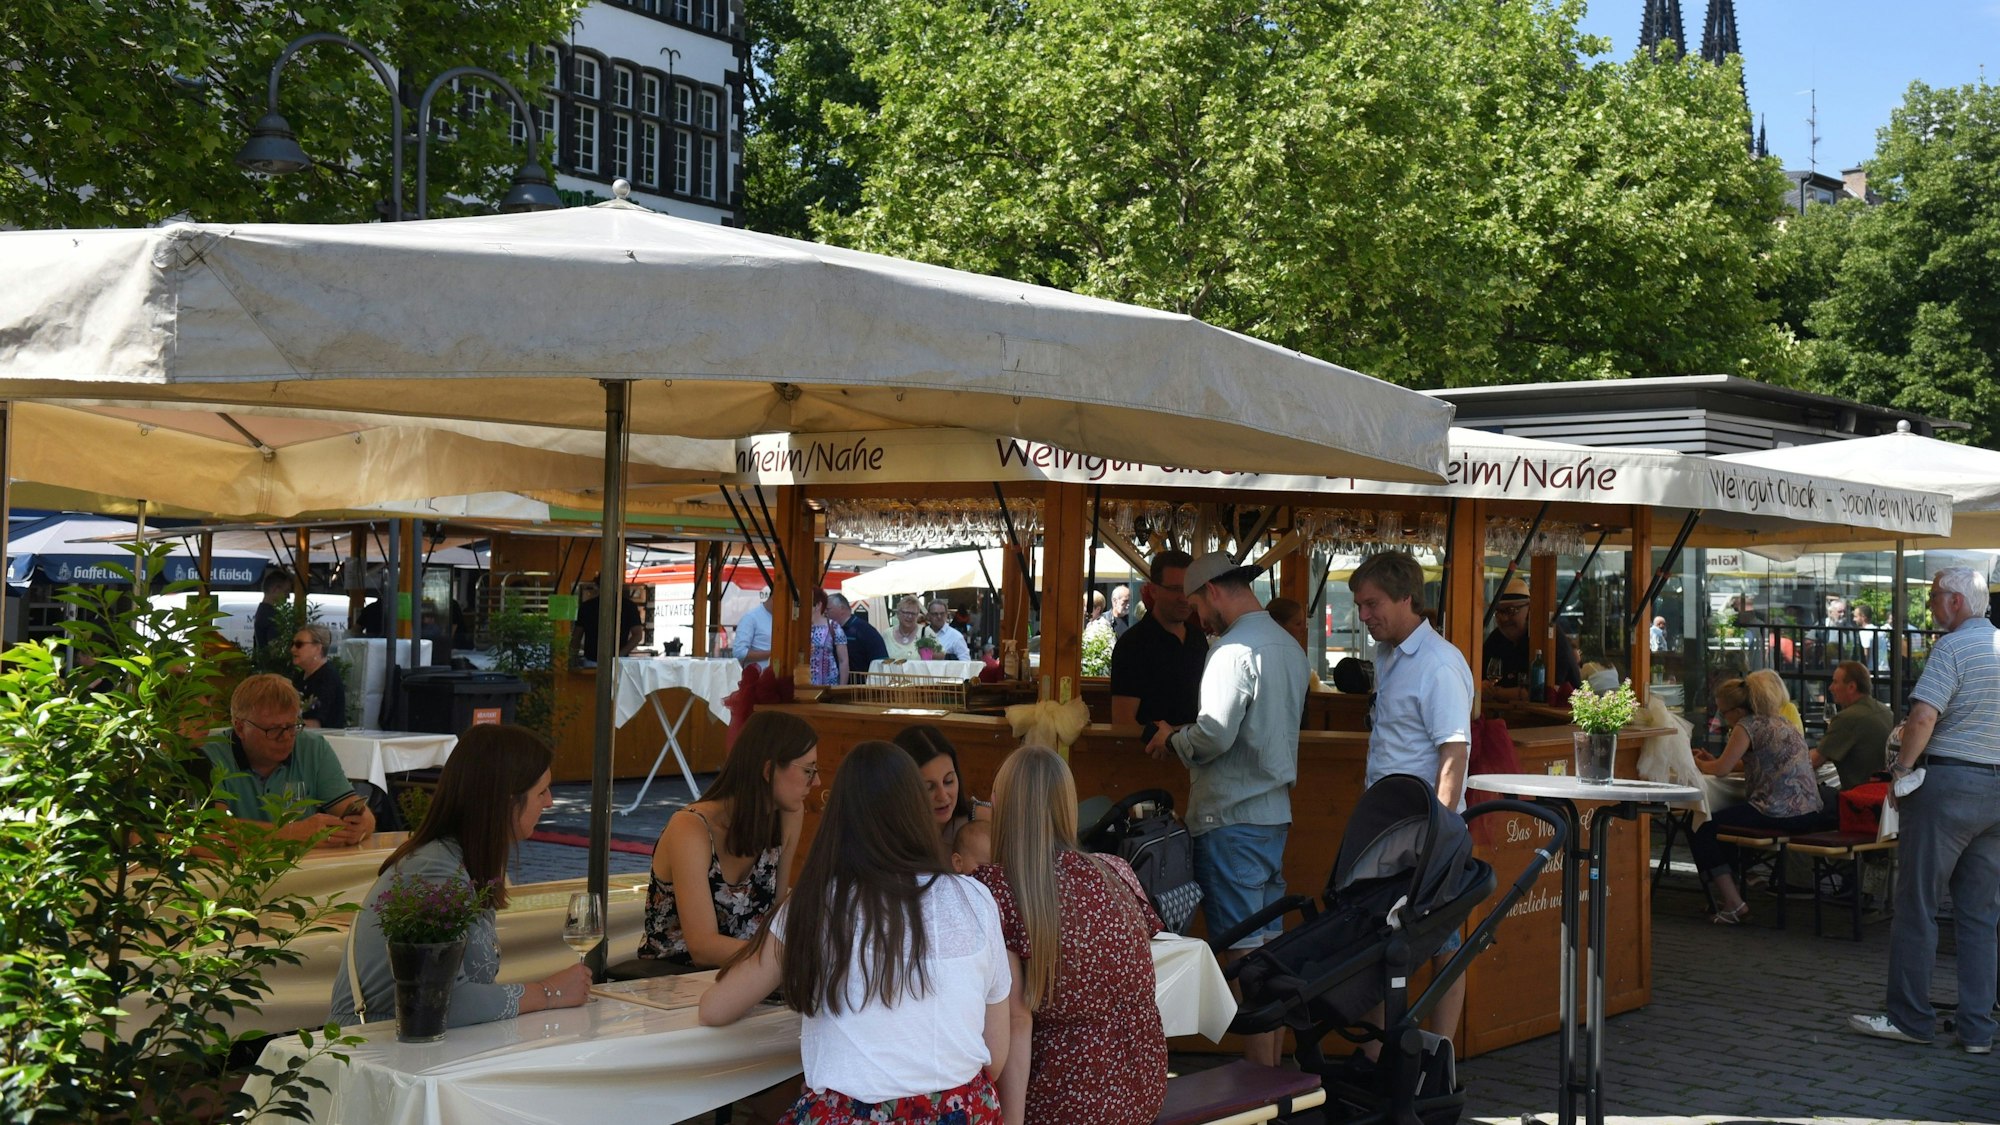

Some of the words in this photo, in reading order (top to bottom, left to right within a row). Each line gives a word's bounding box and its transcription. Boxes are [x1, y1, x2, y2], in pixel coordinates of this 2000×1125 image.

[1710, 468, 1776, 511] Weingut
[73, 566, 108, 580] Gaffel
[1506, 818, 1532, 842] Das
